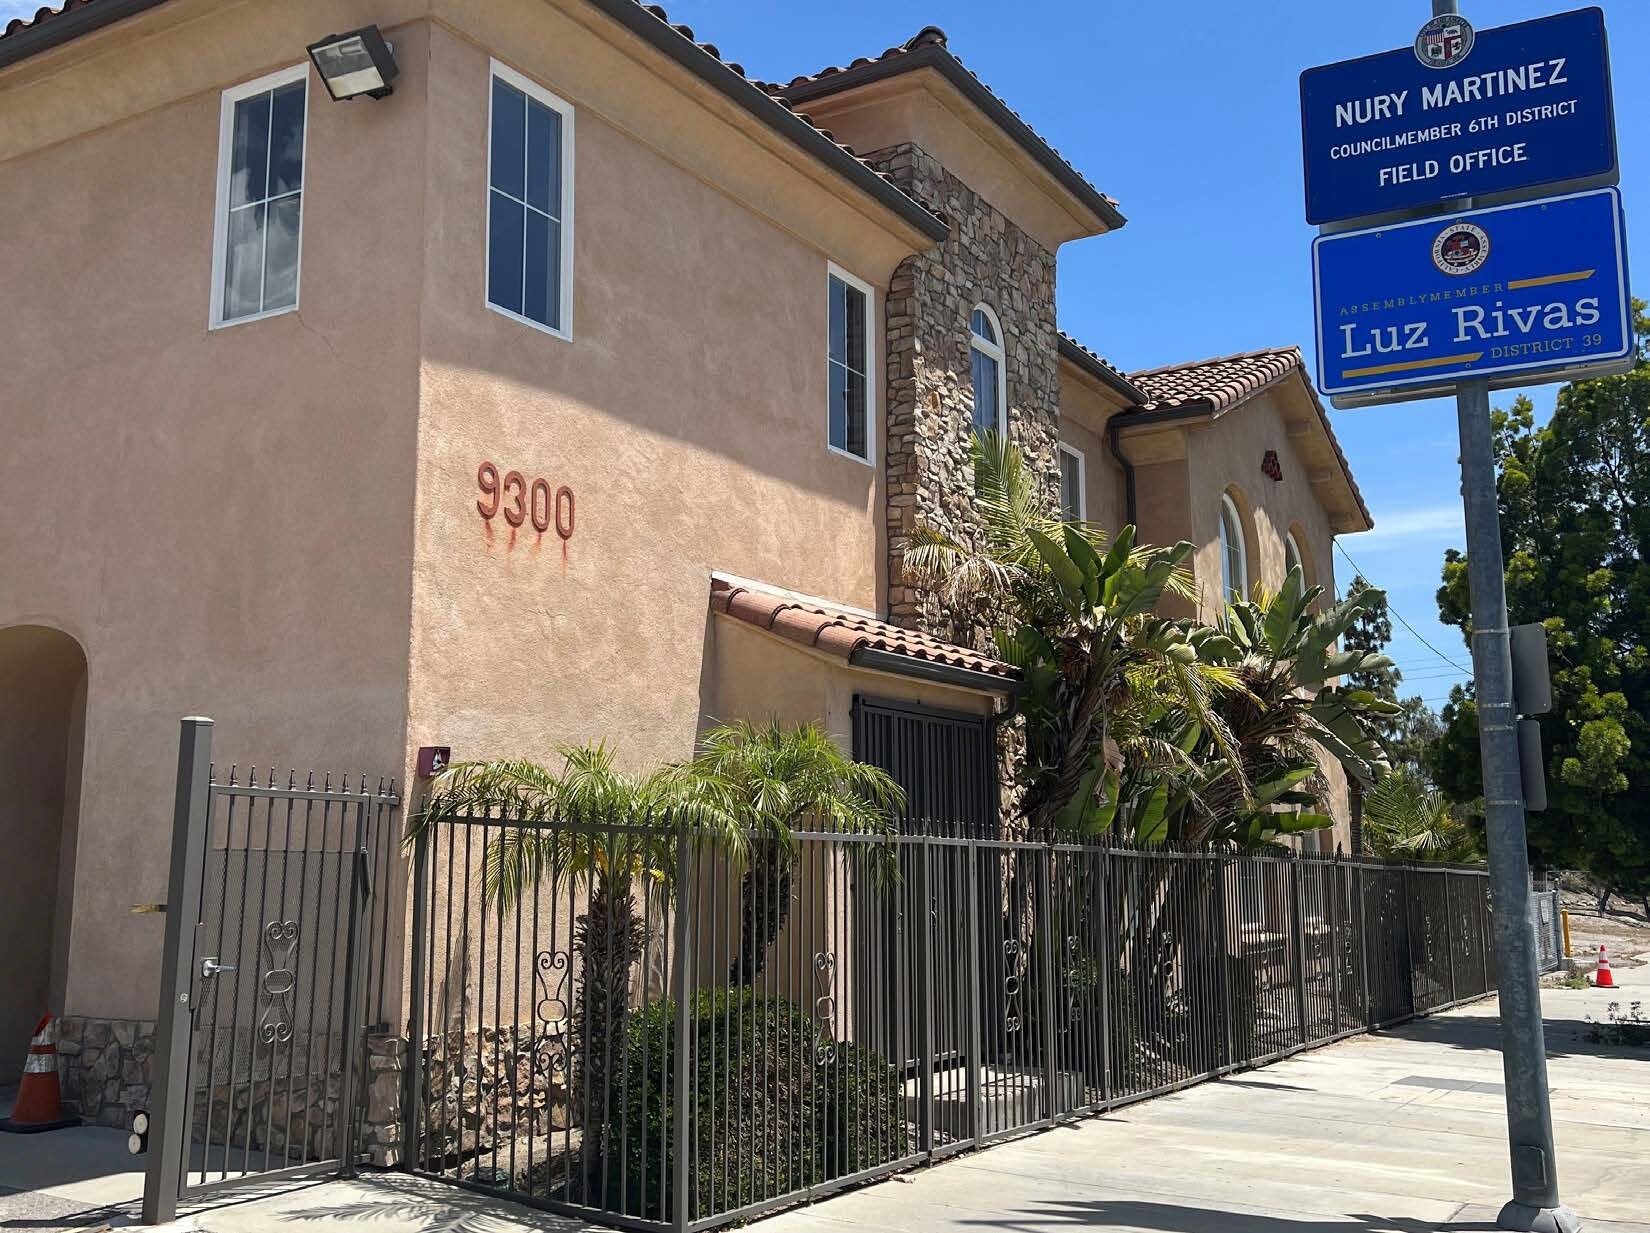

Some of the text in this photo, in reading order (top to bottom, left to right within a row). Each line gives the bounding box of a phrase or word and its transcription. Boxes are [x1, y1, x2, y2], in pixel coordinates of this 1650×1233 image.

[1335, 58, 1568, 127] NURY MARTINEZ
[1330, 99, 1578, 160] COUNCILMEMBER 6TH DISTRICT
[1379, 143, 1527, 187] FIELD OFFICE
[1339, 297, 1600, 359] Luz Rivas
[1340, 283, 1504, 316] ASSEMBLYMEMBER
[1491, 334, 1602, 359] DISTRICT 39
[477, 461, 575, 540] 9300
